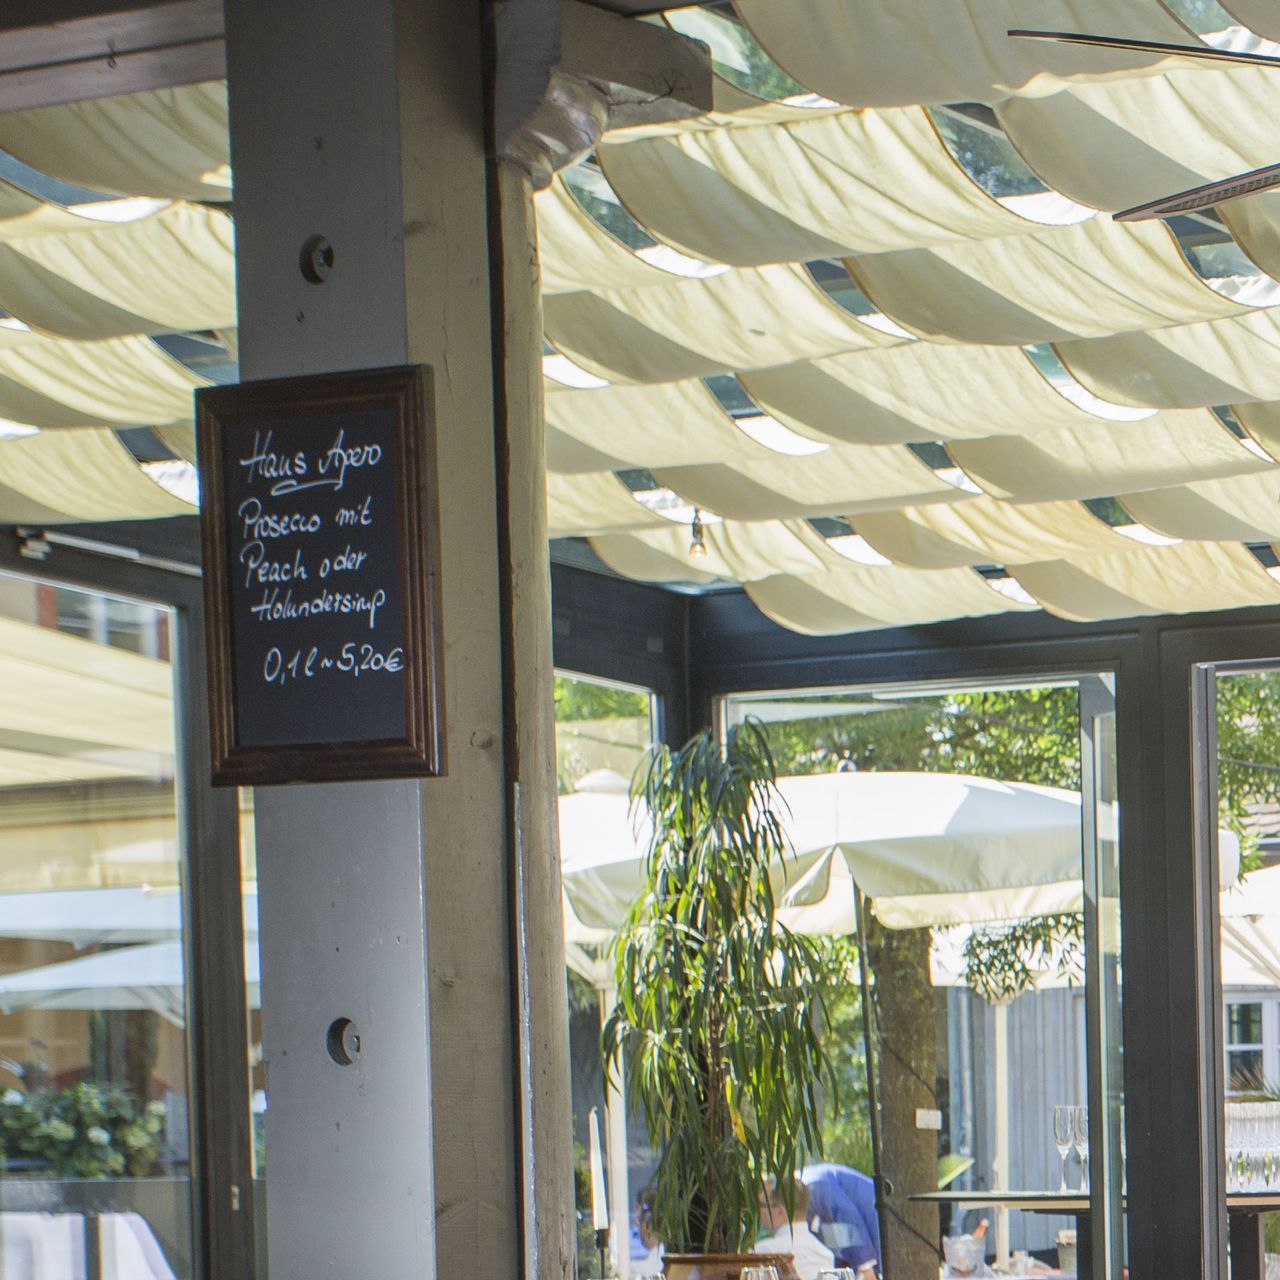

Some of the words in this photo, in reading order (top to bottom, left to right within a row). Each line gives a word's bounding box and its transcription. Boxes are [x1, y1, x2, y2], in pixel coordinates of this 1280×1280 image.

[240, 429, 308, 484] Haus
[318, 428, 382, 483] Apero
[238, 497, 322, 541] Prosecco
[335, 495, 373, 528] mit
[240, 541, 308, 589] Peach
[319, 545, 368, 580] oder
[250, 588, 386, 629] Holundersirup
